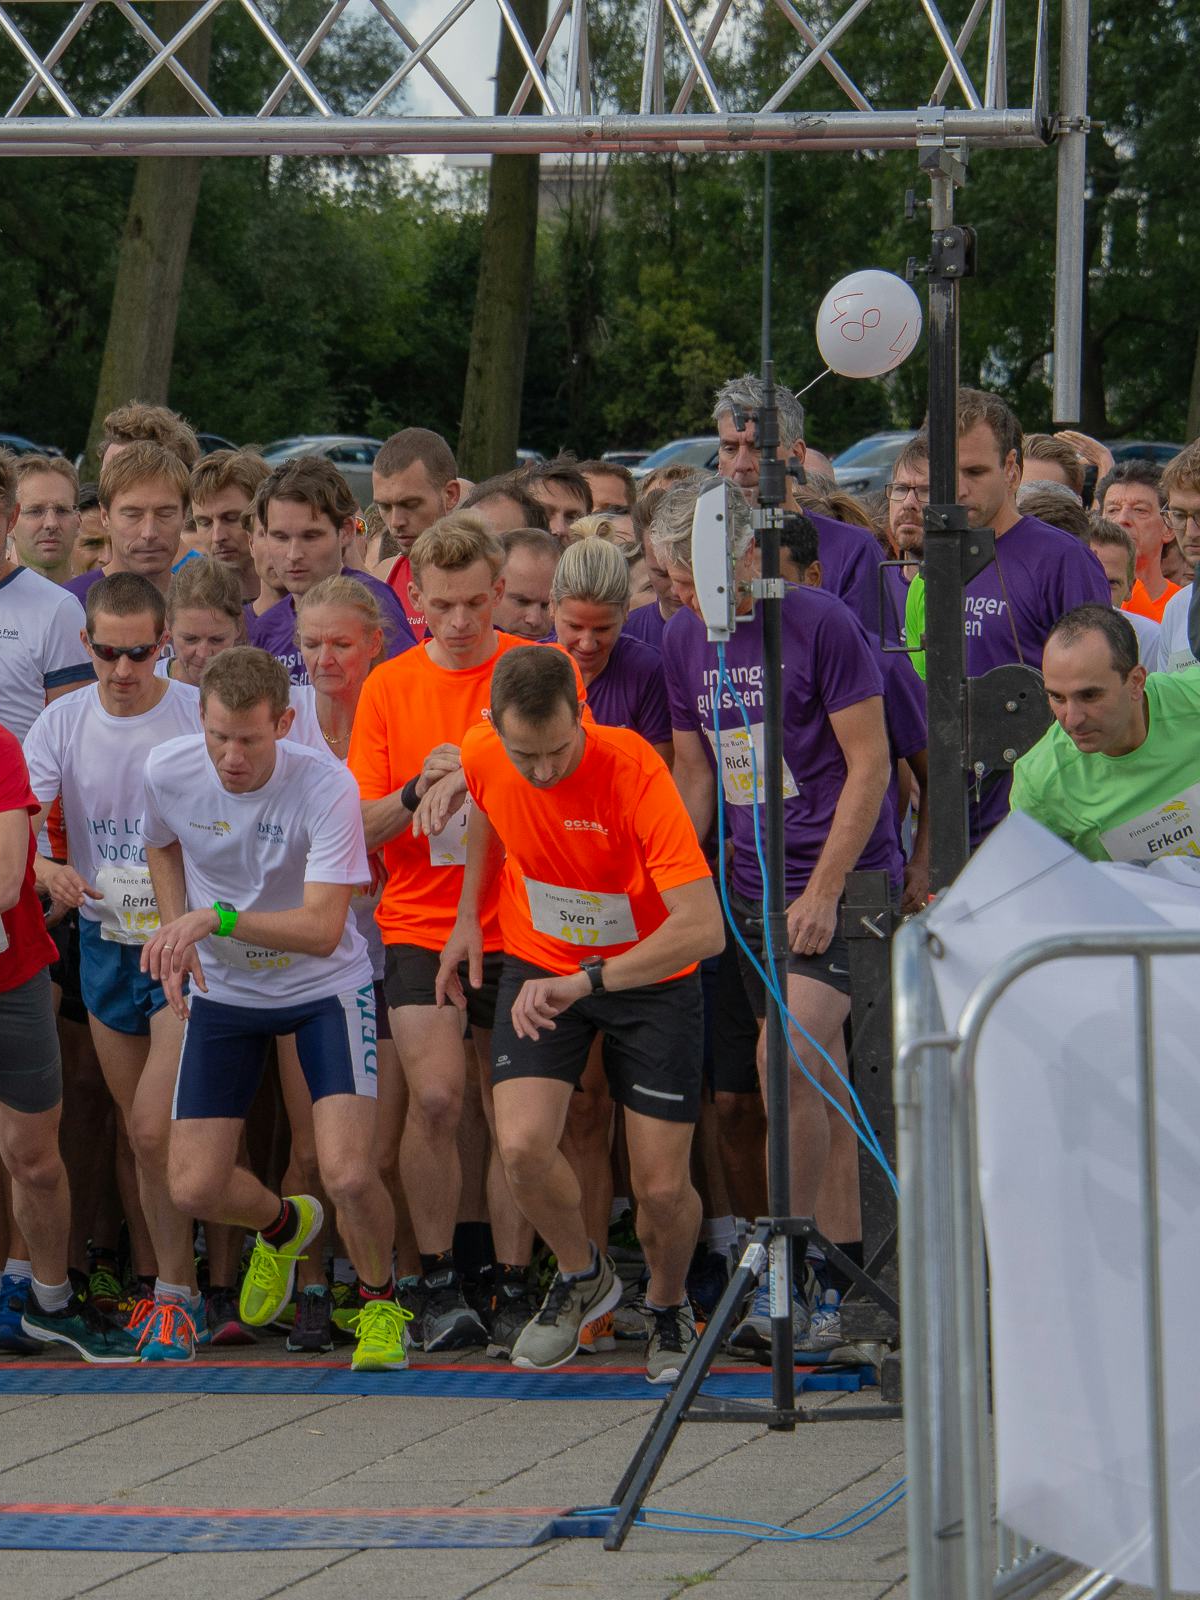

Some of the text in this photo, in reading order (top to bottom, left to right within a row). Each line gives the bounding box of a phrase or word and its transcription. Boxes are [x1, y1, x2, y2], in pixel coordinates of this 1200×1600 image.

[964, 596, 1008, 620] nger
[964, 619, 982, 637] en
[725, 754, 751, 770] Rick
[1146, 824, 1194, 854] Erkan
[559, 910, 596, 926] Sven
